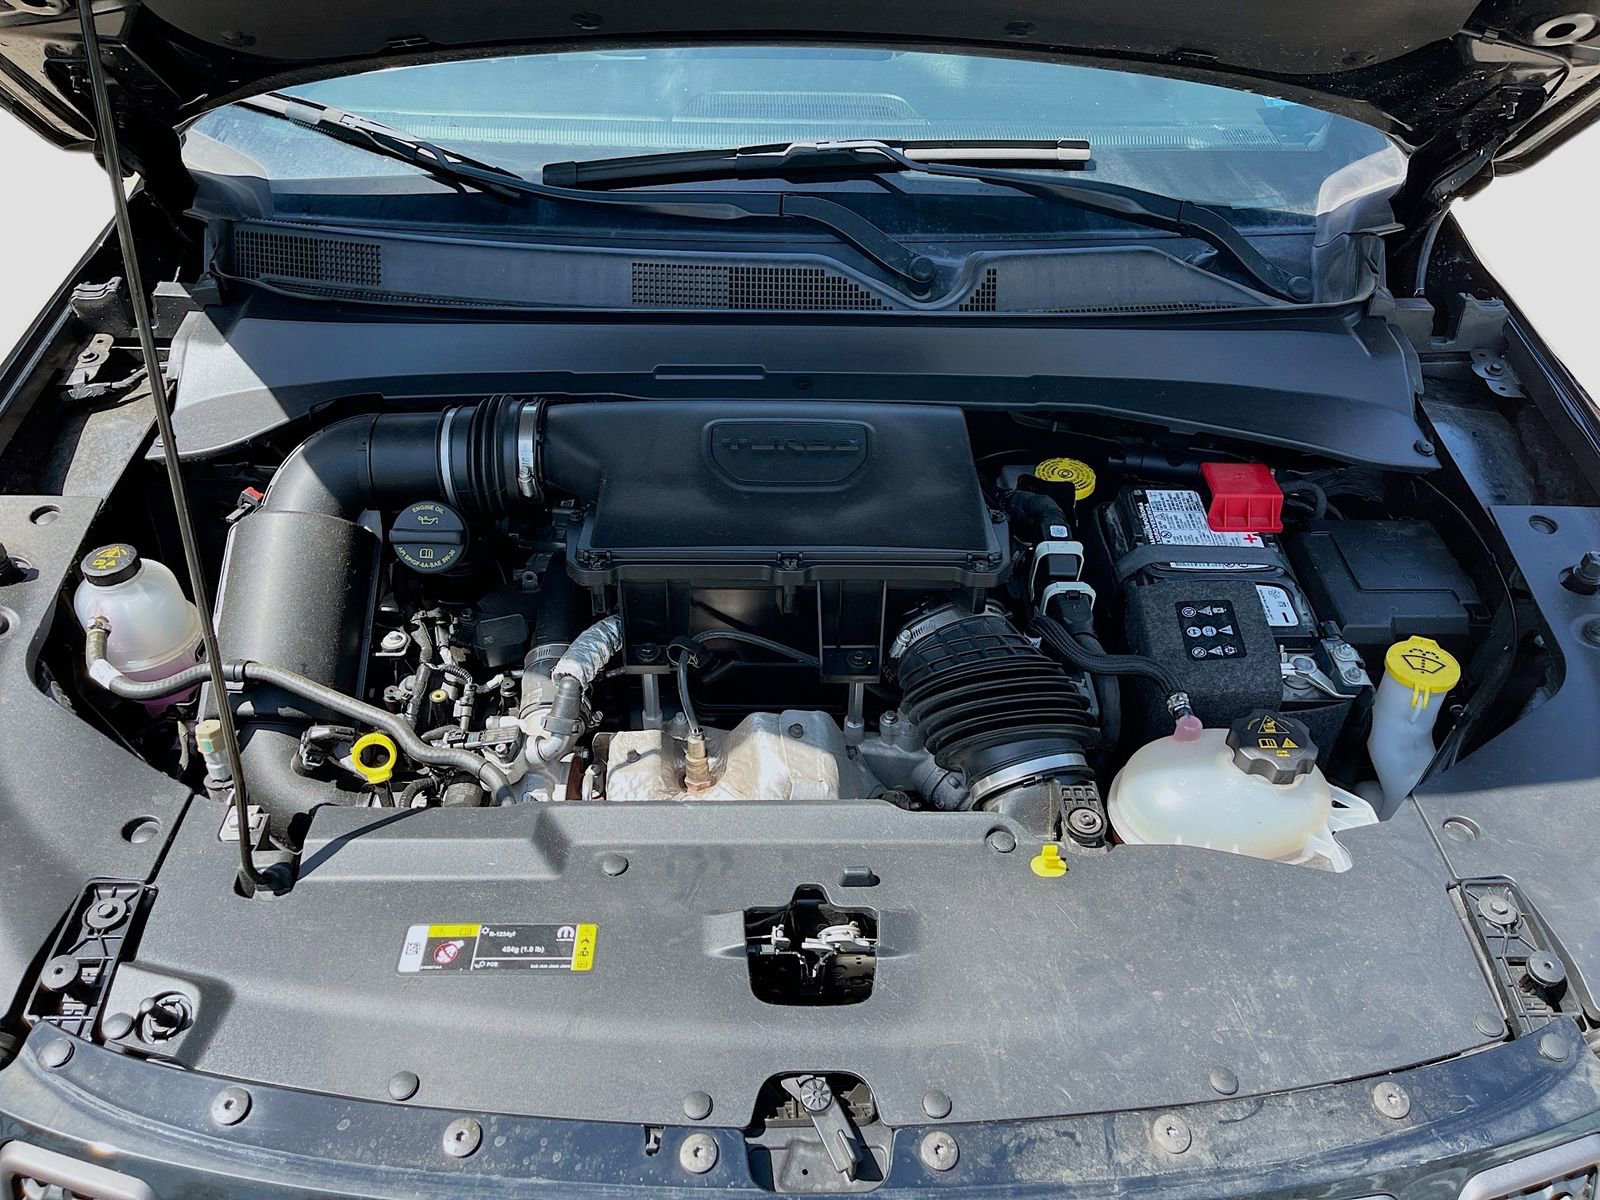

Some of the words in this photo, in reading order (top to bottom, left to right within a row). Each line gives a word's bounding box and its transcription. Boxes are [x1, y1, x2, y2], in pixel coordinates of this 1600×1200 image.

[435, 506, 444, 515] OIL
[398, 547, 406, 556] API
[535, 945, 545, 953] lb)
